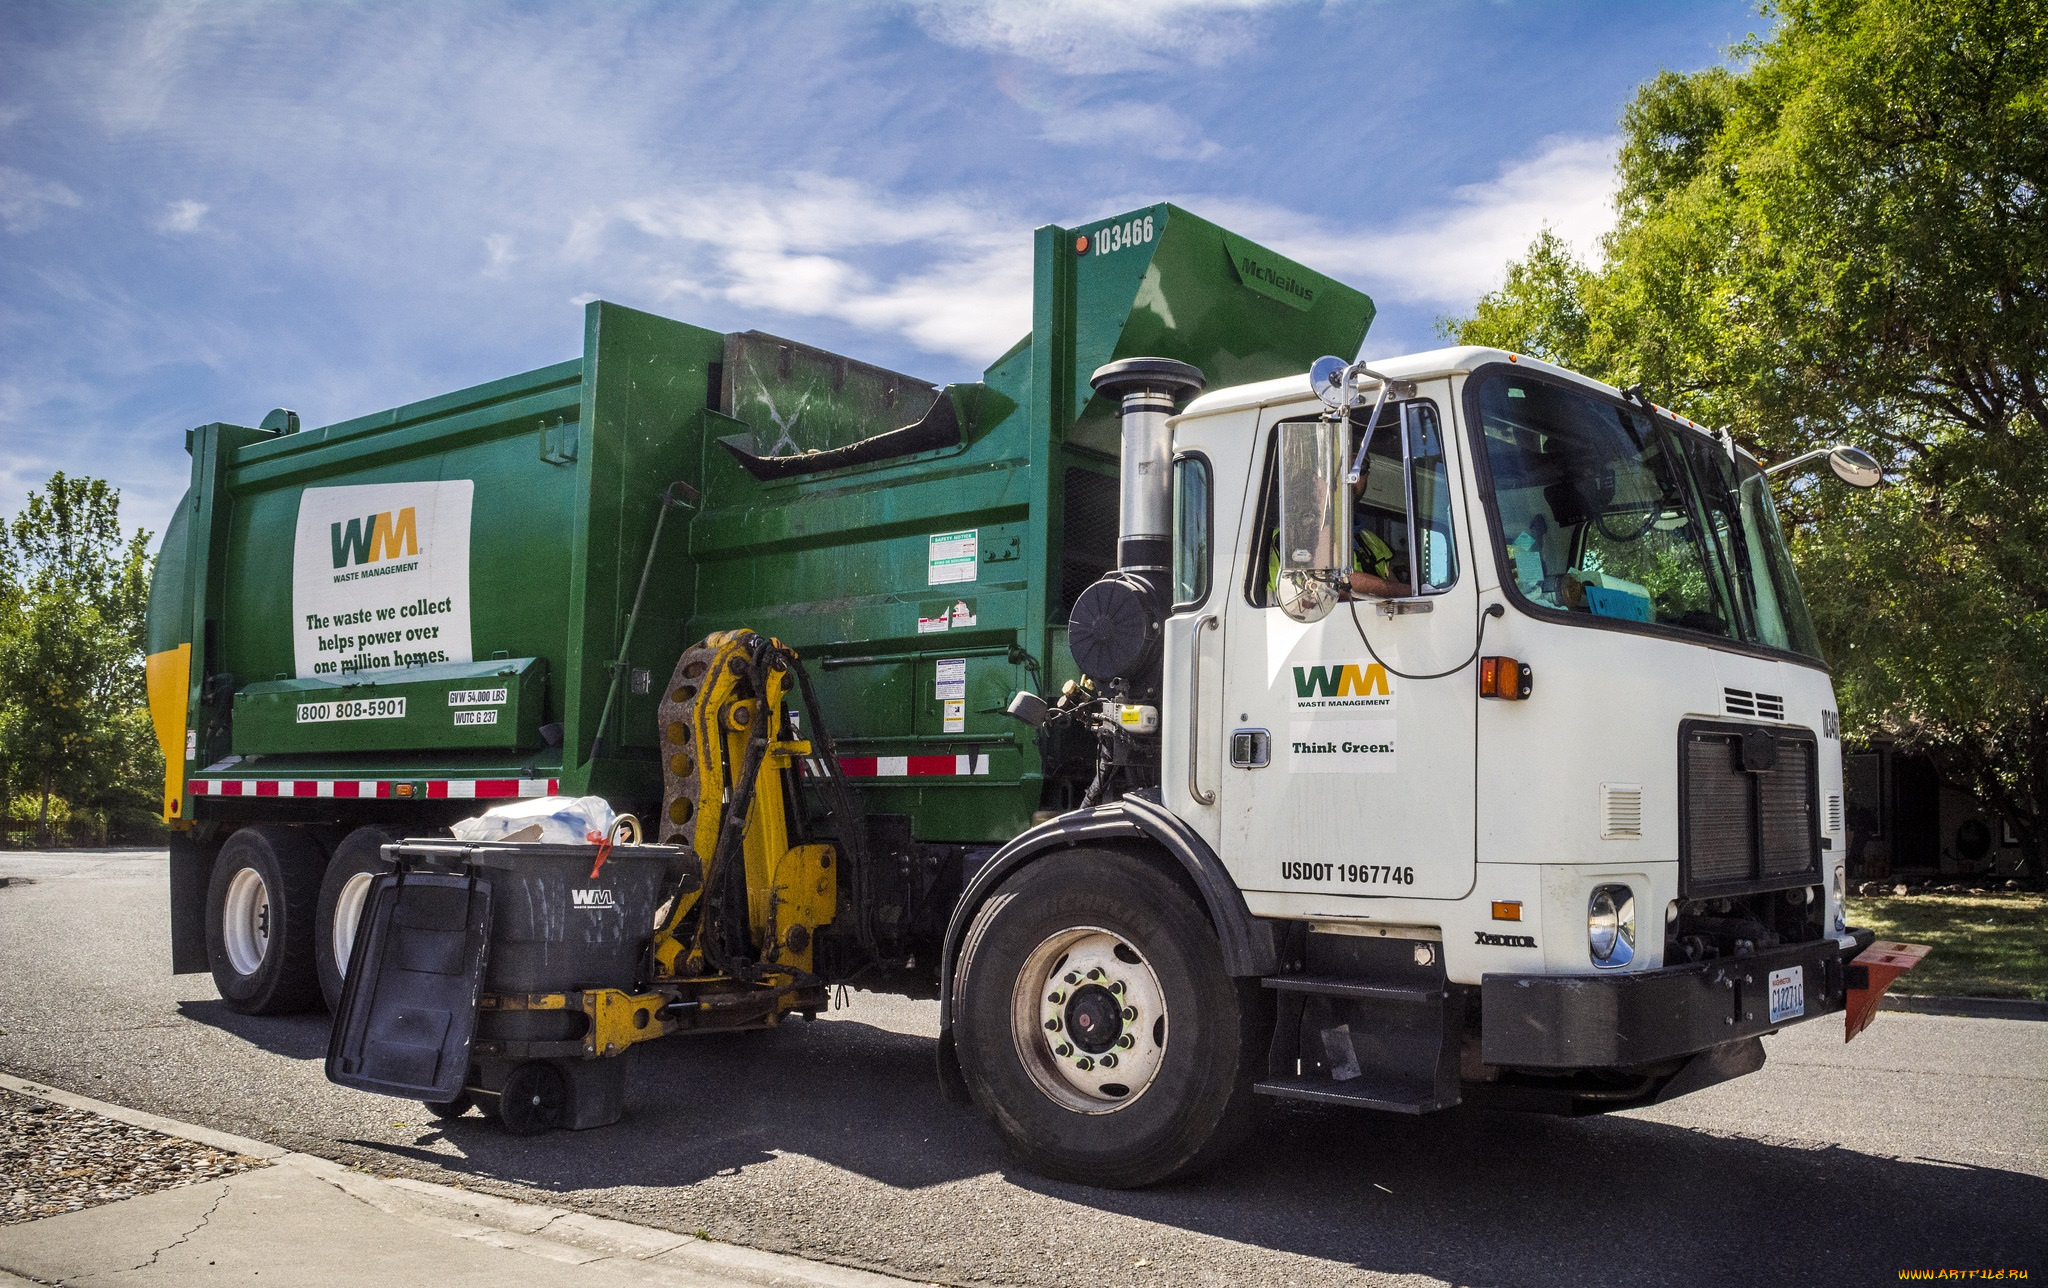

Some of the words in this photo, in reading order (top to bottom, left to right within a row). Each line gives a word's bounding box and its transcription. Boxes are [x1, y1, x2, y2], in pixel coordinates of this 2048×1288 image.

[1094, 216, 1153, 256] 103466
[1241, 257, 1313, 301] McNeilus
[331, 507, 418, 569] WM
[333, 572, 359, 583] WASTE
[361, 562, 418, 579] MANAGEMENT
[306, 614, 330, 630] The
[333, 608, 372, 627] waste
[376, 607, 396, 621] we
[400, 596, 452, 618] collect
[318, 634, 354, 653] helps
[358, 630, 401, 651] power
[406, 626, 439, 641] over
[314, 660, 337, 674] one
[341, 652, 390, 672] million
[394, 650, 450, 666] homes.
[1292, 663, 1390, 698] WM
[450, 692, 466, 704] GVW
[467, 691, 490, 704] 54,000
[492, 690, 505, 702] LBS
[1328, 699, 1390, 707] MANAGEMENT
[297, 704, 330, 720] (800)
[336, 699, 404, 718] 808-5901
[455, 712, 475, 724] WUTC
[476, 712, 482, 723] G
[483, 711, 496, 723] 237
[1292, 742, 1337, 754] Think
[1281, 862, 1334, 881] USDOT
[1337, 864, 1414, 885] 1967746
[571, 889, 613, 905] WM
